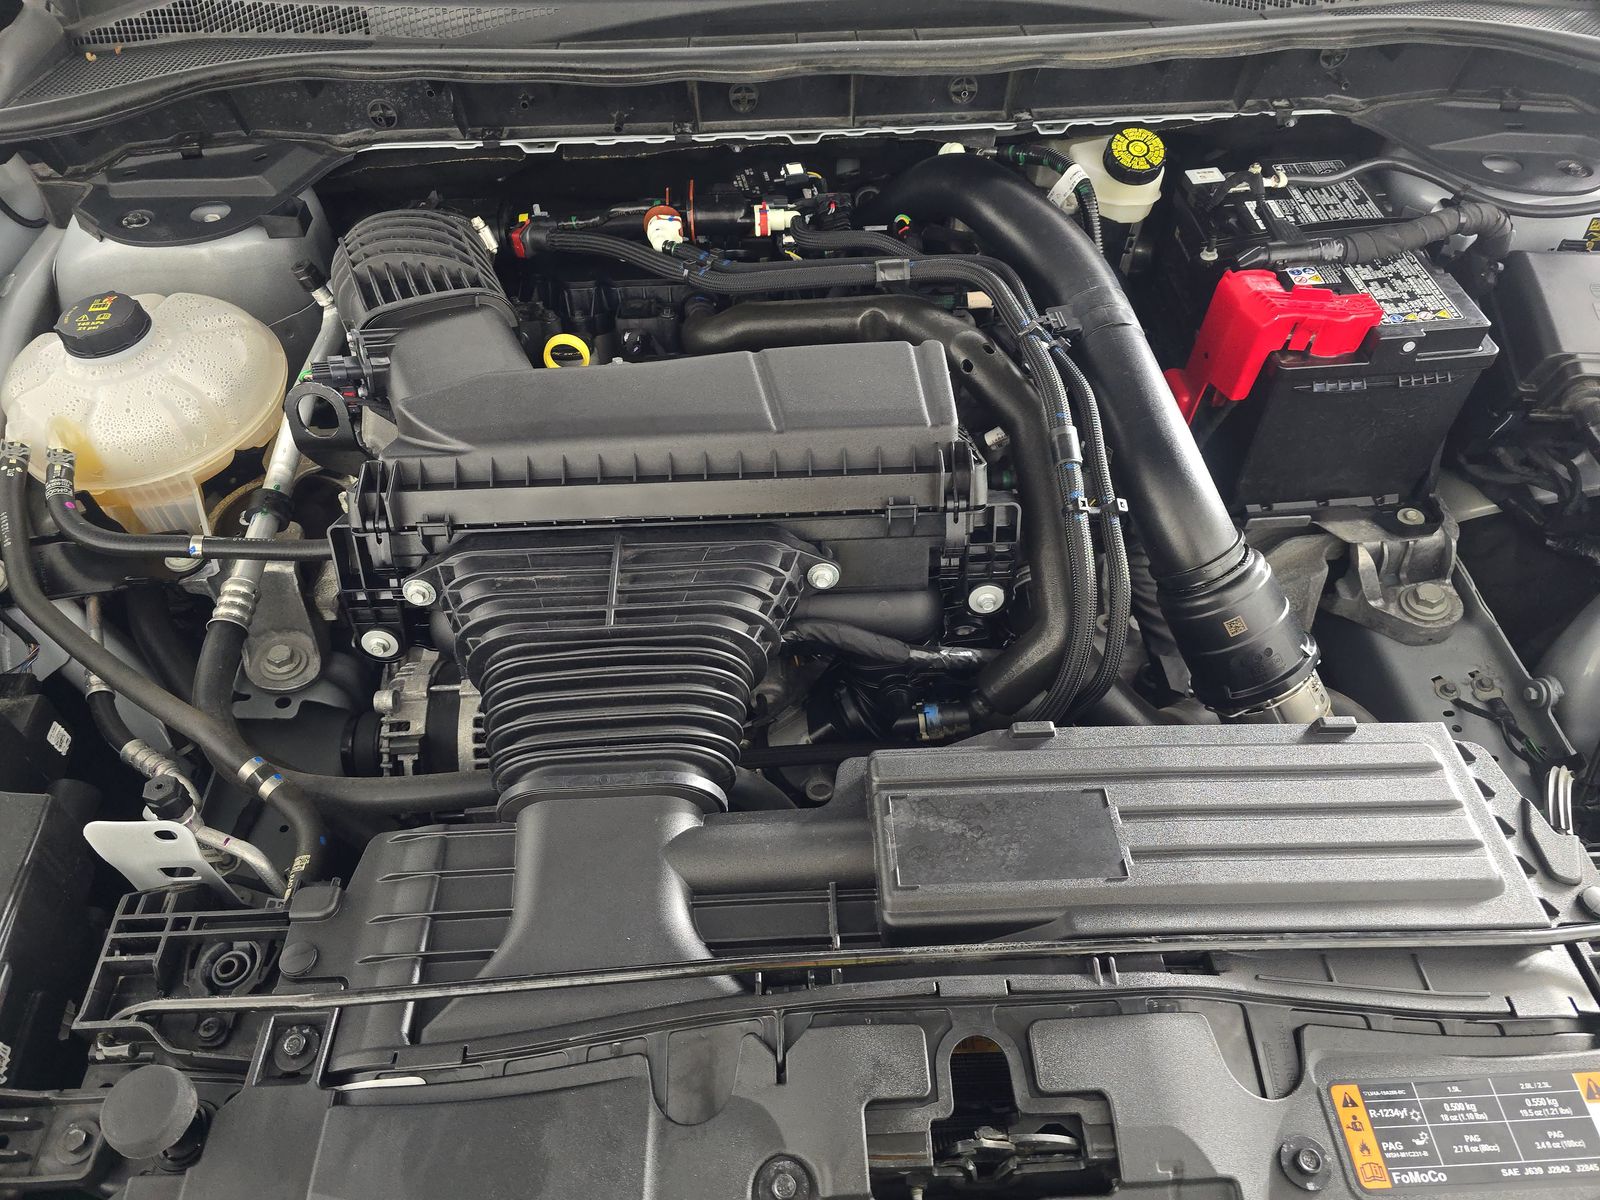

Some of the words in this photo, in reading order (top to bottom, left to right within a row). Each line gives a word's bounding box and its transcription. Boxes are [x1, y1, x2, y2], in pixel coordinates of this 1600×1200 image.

[1443, 1102, 1465, 1112] 0.500
[1464, 1102, 1477, 1113] kg
[1525, 1097, 1546, 1107] 0.550
[1546, 1097, 1559, 1108] kg
[1368, 1107, 1408, 1119] R-1234yf
[1463, 1134, 1482, 1142] PAG
[1546, 1130, 1565, 1139] PAG
[1381, 1141, 1404, 1151] PAG
[1452, 1144, 1463, 1153] 2.7
[1391, 1169, 1448, 1184] FoMoCo
[1501, 1167, 1521, 1177] SAE
